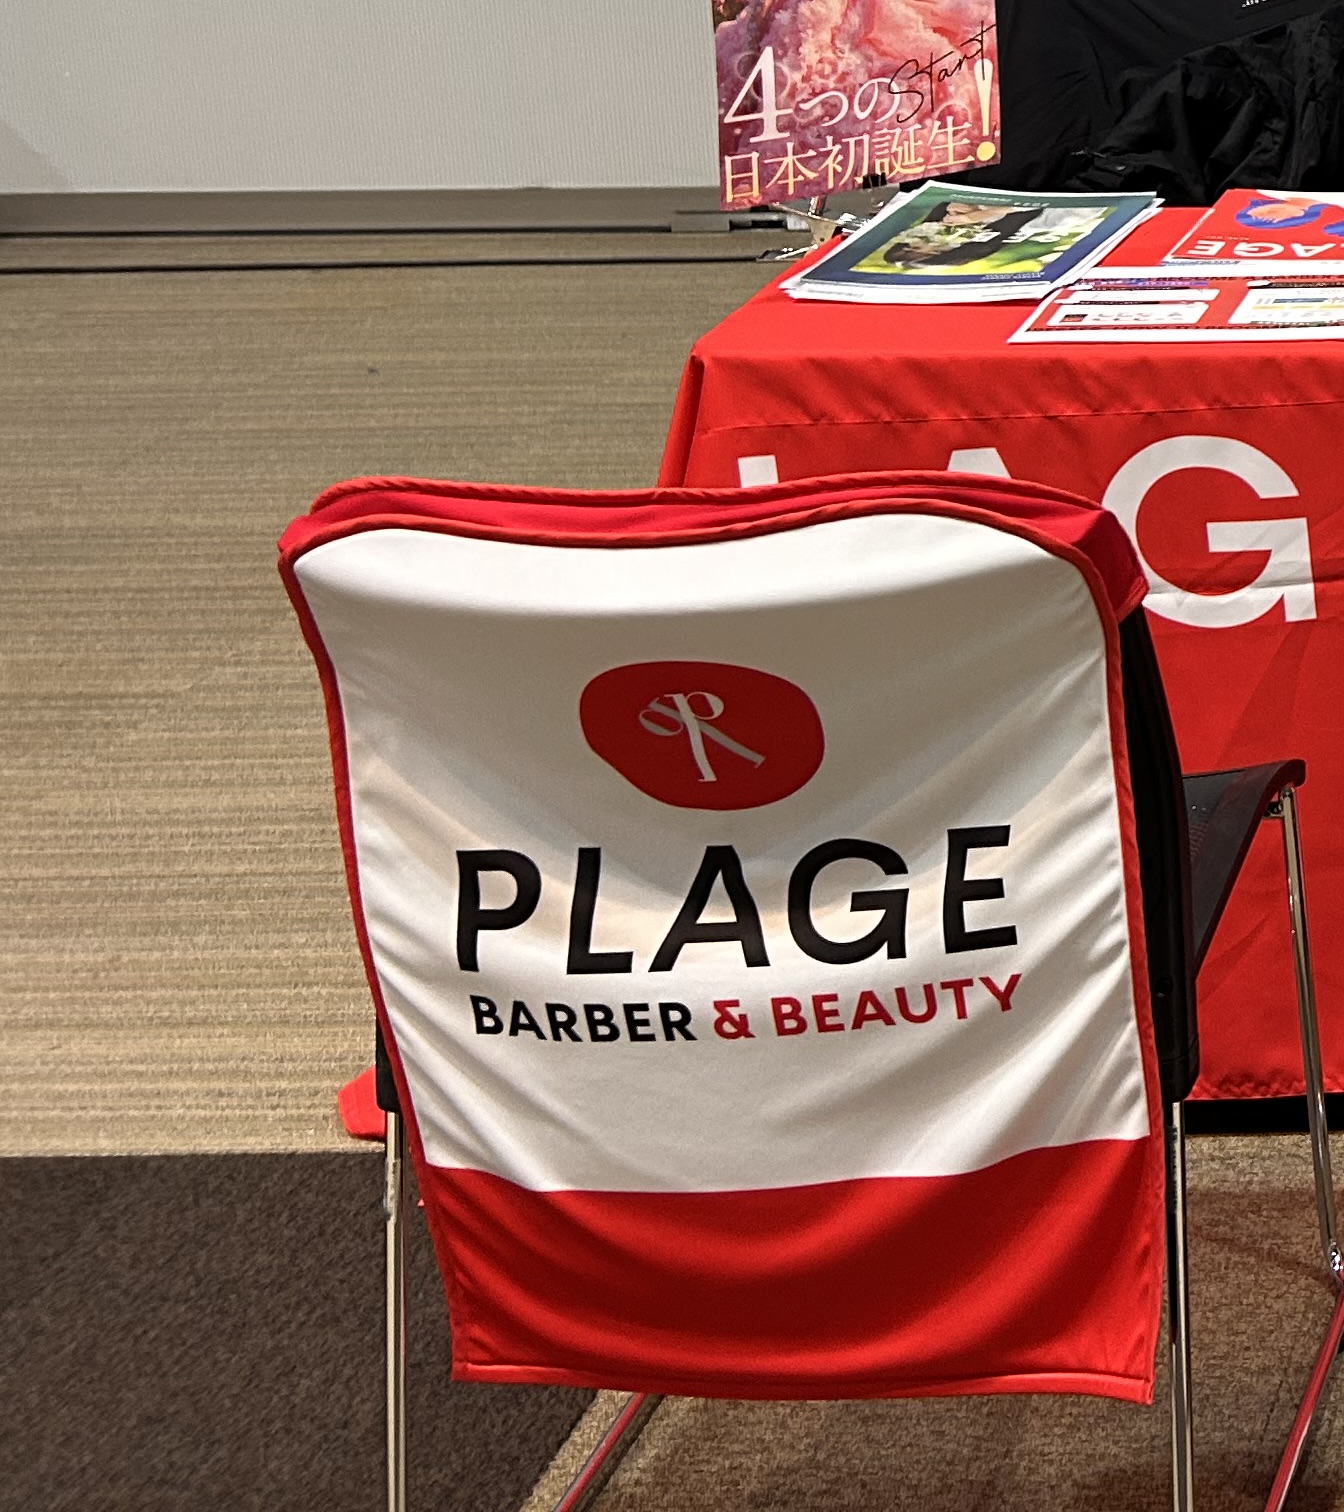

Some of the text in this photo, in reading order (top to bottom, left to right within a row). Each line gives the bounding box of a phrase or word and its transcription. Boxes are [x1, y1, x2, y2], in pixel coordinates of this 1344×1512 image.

[723, 46, 902, 144] 4つの
[724, 59, 997, 203] 日本初誕生!
[456, 825, 1018, 975] PLAGE
[469, 973, 1022, 1042] BARBER & BEAUTY
